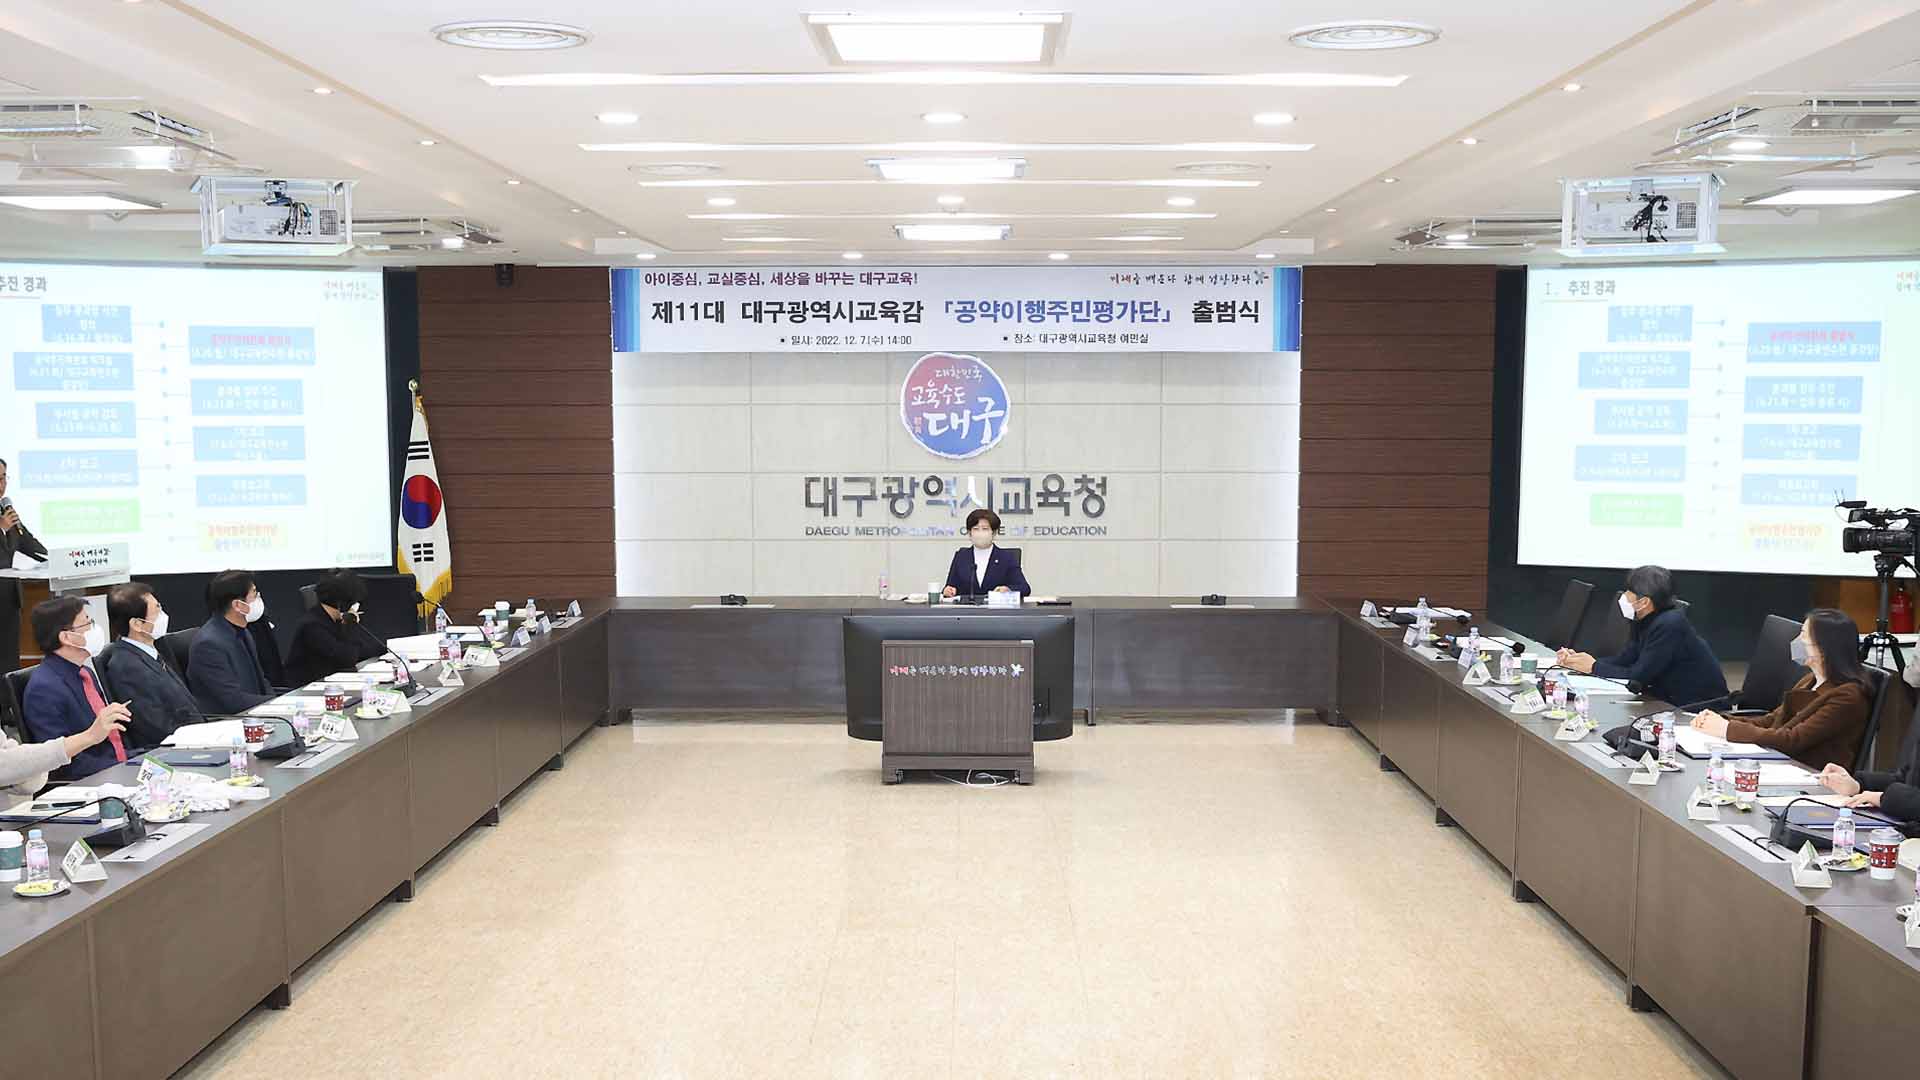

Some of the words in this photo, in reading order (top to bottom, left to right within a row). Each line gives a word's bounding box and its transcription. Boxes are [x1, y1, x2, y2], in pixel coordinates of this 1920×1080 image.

[23, 276, 47, 293] 경과
[645, 272, 702, 287] 아이중심,
[707, 272, 765, 287] 교실중심,
[770, 272, 810, 286] 세상을
[815, 272, 855, 286] 바꾸는
[859, 272, 918, 286] 대구교육!
[1568, 280, 1590, 296] 추진
[1593, 280, 1616, 295] 경과
[652, 301, 725, 324] 제11대
[741, 301, 924, 324] 대구광역시교육감
[944, 300, 1171, 324] 「공약이행주민평가단」
[1191, 301, 1260, 324] 출범식
[791, 336, 814, 346] 일시:
[816, 336, 841, 346] 2022.
[887, 336, 912, 346] 14:00
[1039, 333, 1117, 344] 대구광역시교육청
[1120, 333, 1149, 344] 여민실
[936, 365, 983, 383] 대한민국
[911, 379, 966, 408] 교육수도
[922, 397, 1005, 444] 대구
[804, 474, 1108, 519] 대구광역시교육청
[805, 526, 849, 536] DAEGU
[1034, 526, 1107, 536] EDUCATION
